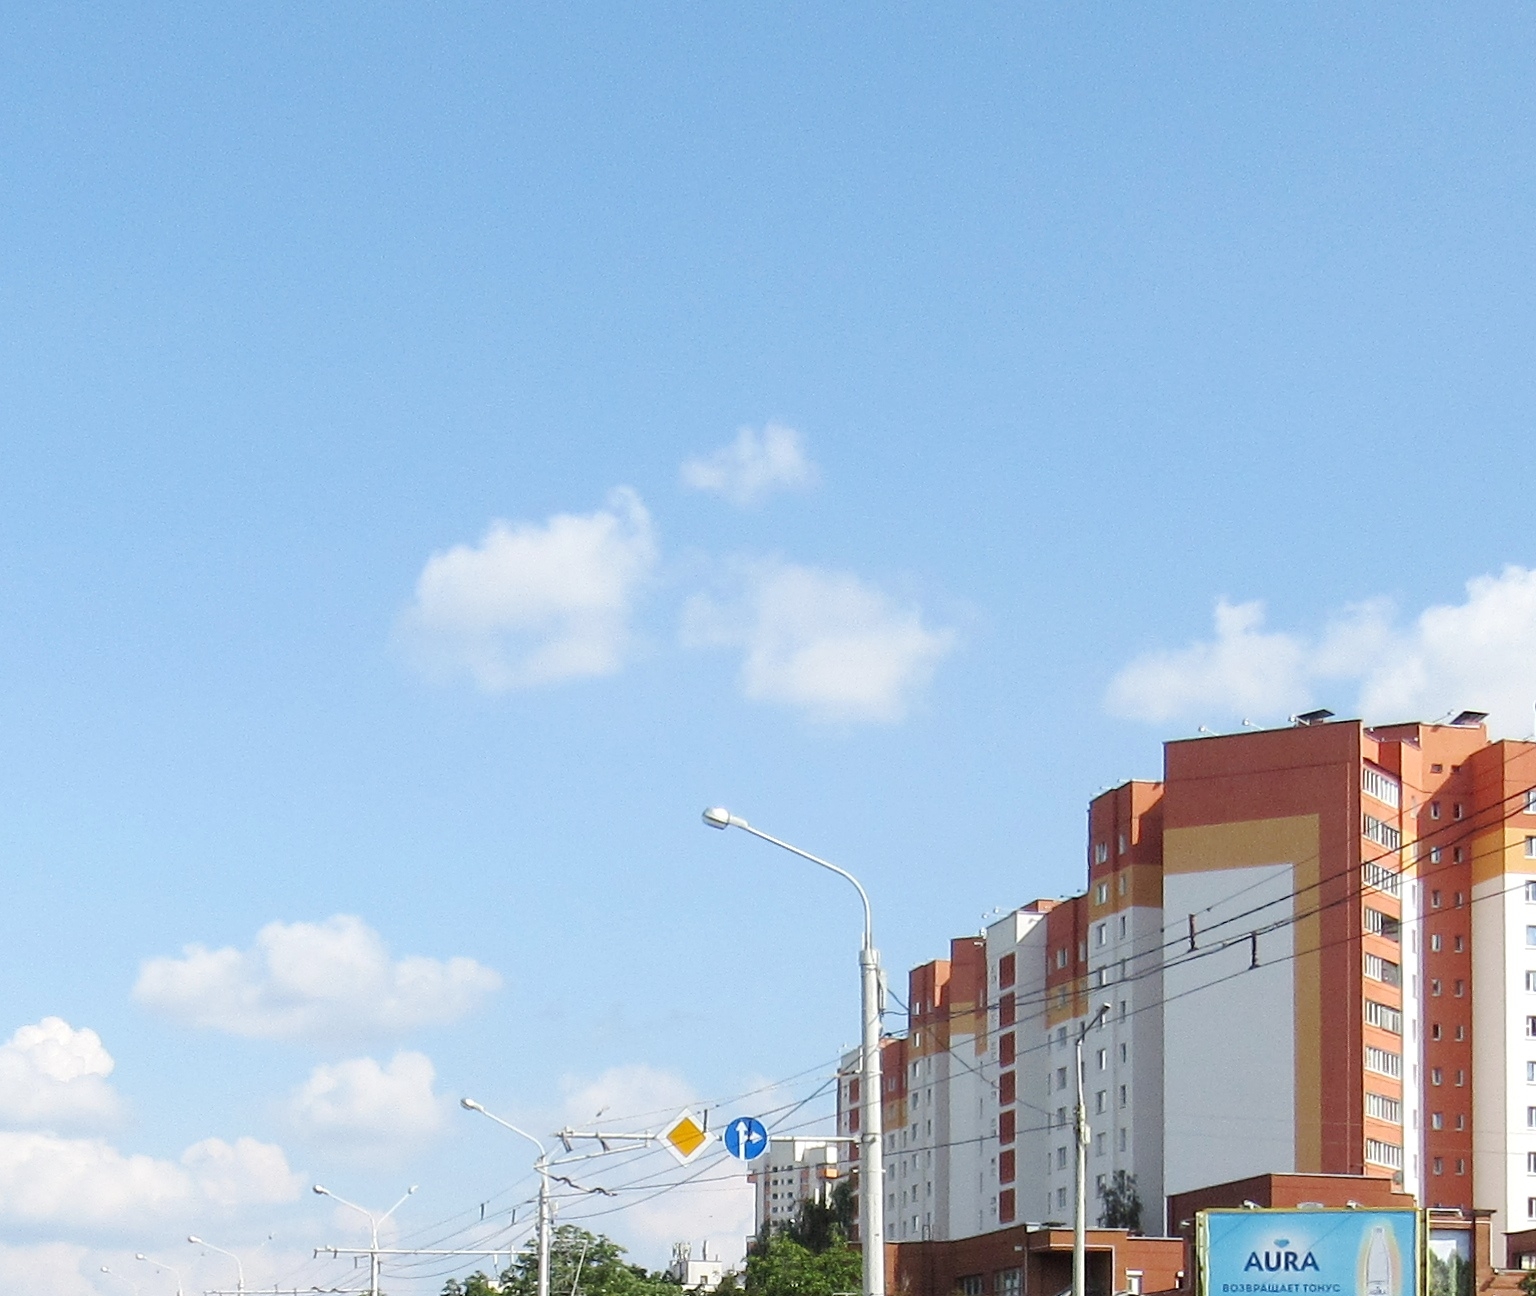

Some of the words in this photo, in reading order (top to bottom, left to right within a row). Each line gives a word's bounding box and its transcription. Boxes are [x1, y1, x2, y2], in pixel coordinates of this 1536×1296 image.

[1243, 1250, 1321, 1273] AURA
[1222, 1283, 1299, 1294] ВОЗВРАЩАЕТ
[1303, 1283, 1341, 1293] ТОНУС
